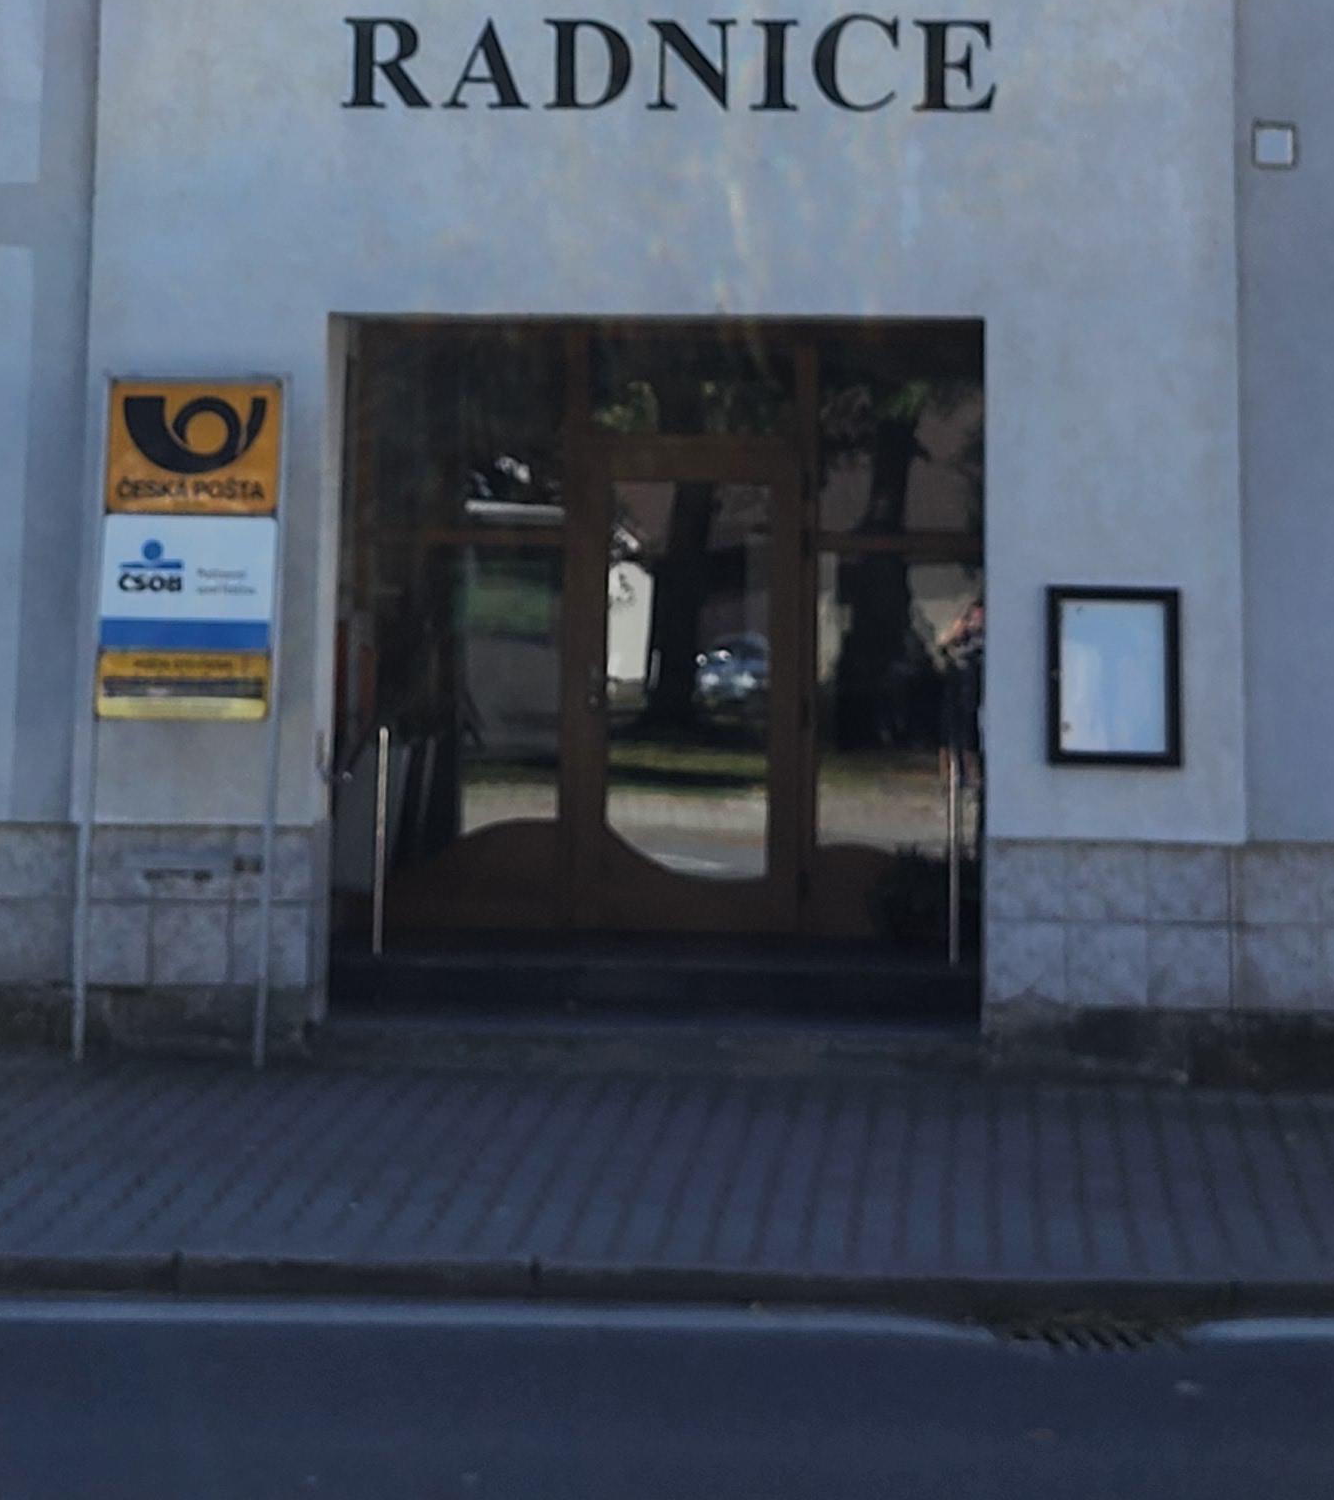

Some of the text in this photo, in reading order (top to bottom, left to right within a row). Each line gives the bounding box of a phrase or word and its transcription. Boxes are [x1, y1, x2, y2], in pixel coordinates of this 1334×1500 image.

[341, 14, 997, 113] RADNICE
[117, 476, 265, 499] ČESKÁ POŠTA
